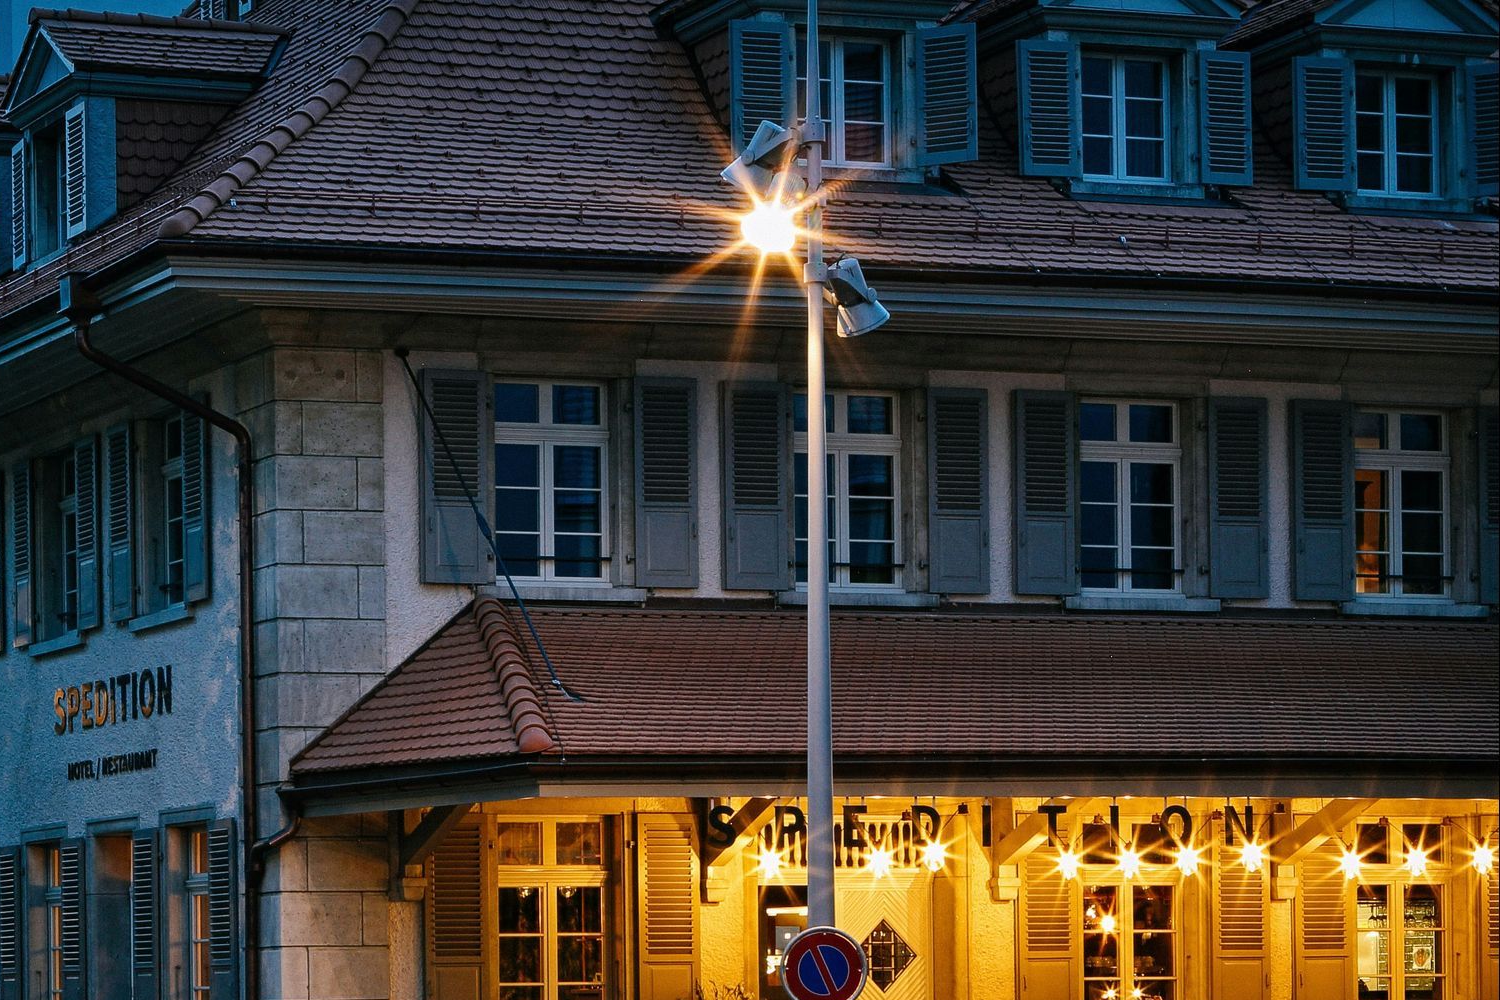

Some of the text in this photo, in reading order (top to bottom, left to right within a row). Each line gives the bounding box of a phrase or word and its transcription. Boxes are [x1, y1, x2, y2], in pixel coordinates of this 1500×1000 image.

[54, 665, 172, 735] SPEDITION
[68, 760, 95, 781] HOTEL
[102, 749, 158, 776] RESTAURANT
[708, 804, 1254, 848] SPEDITION
